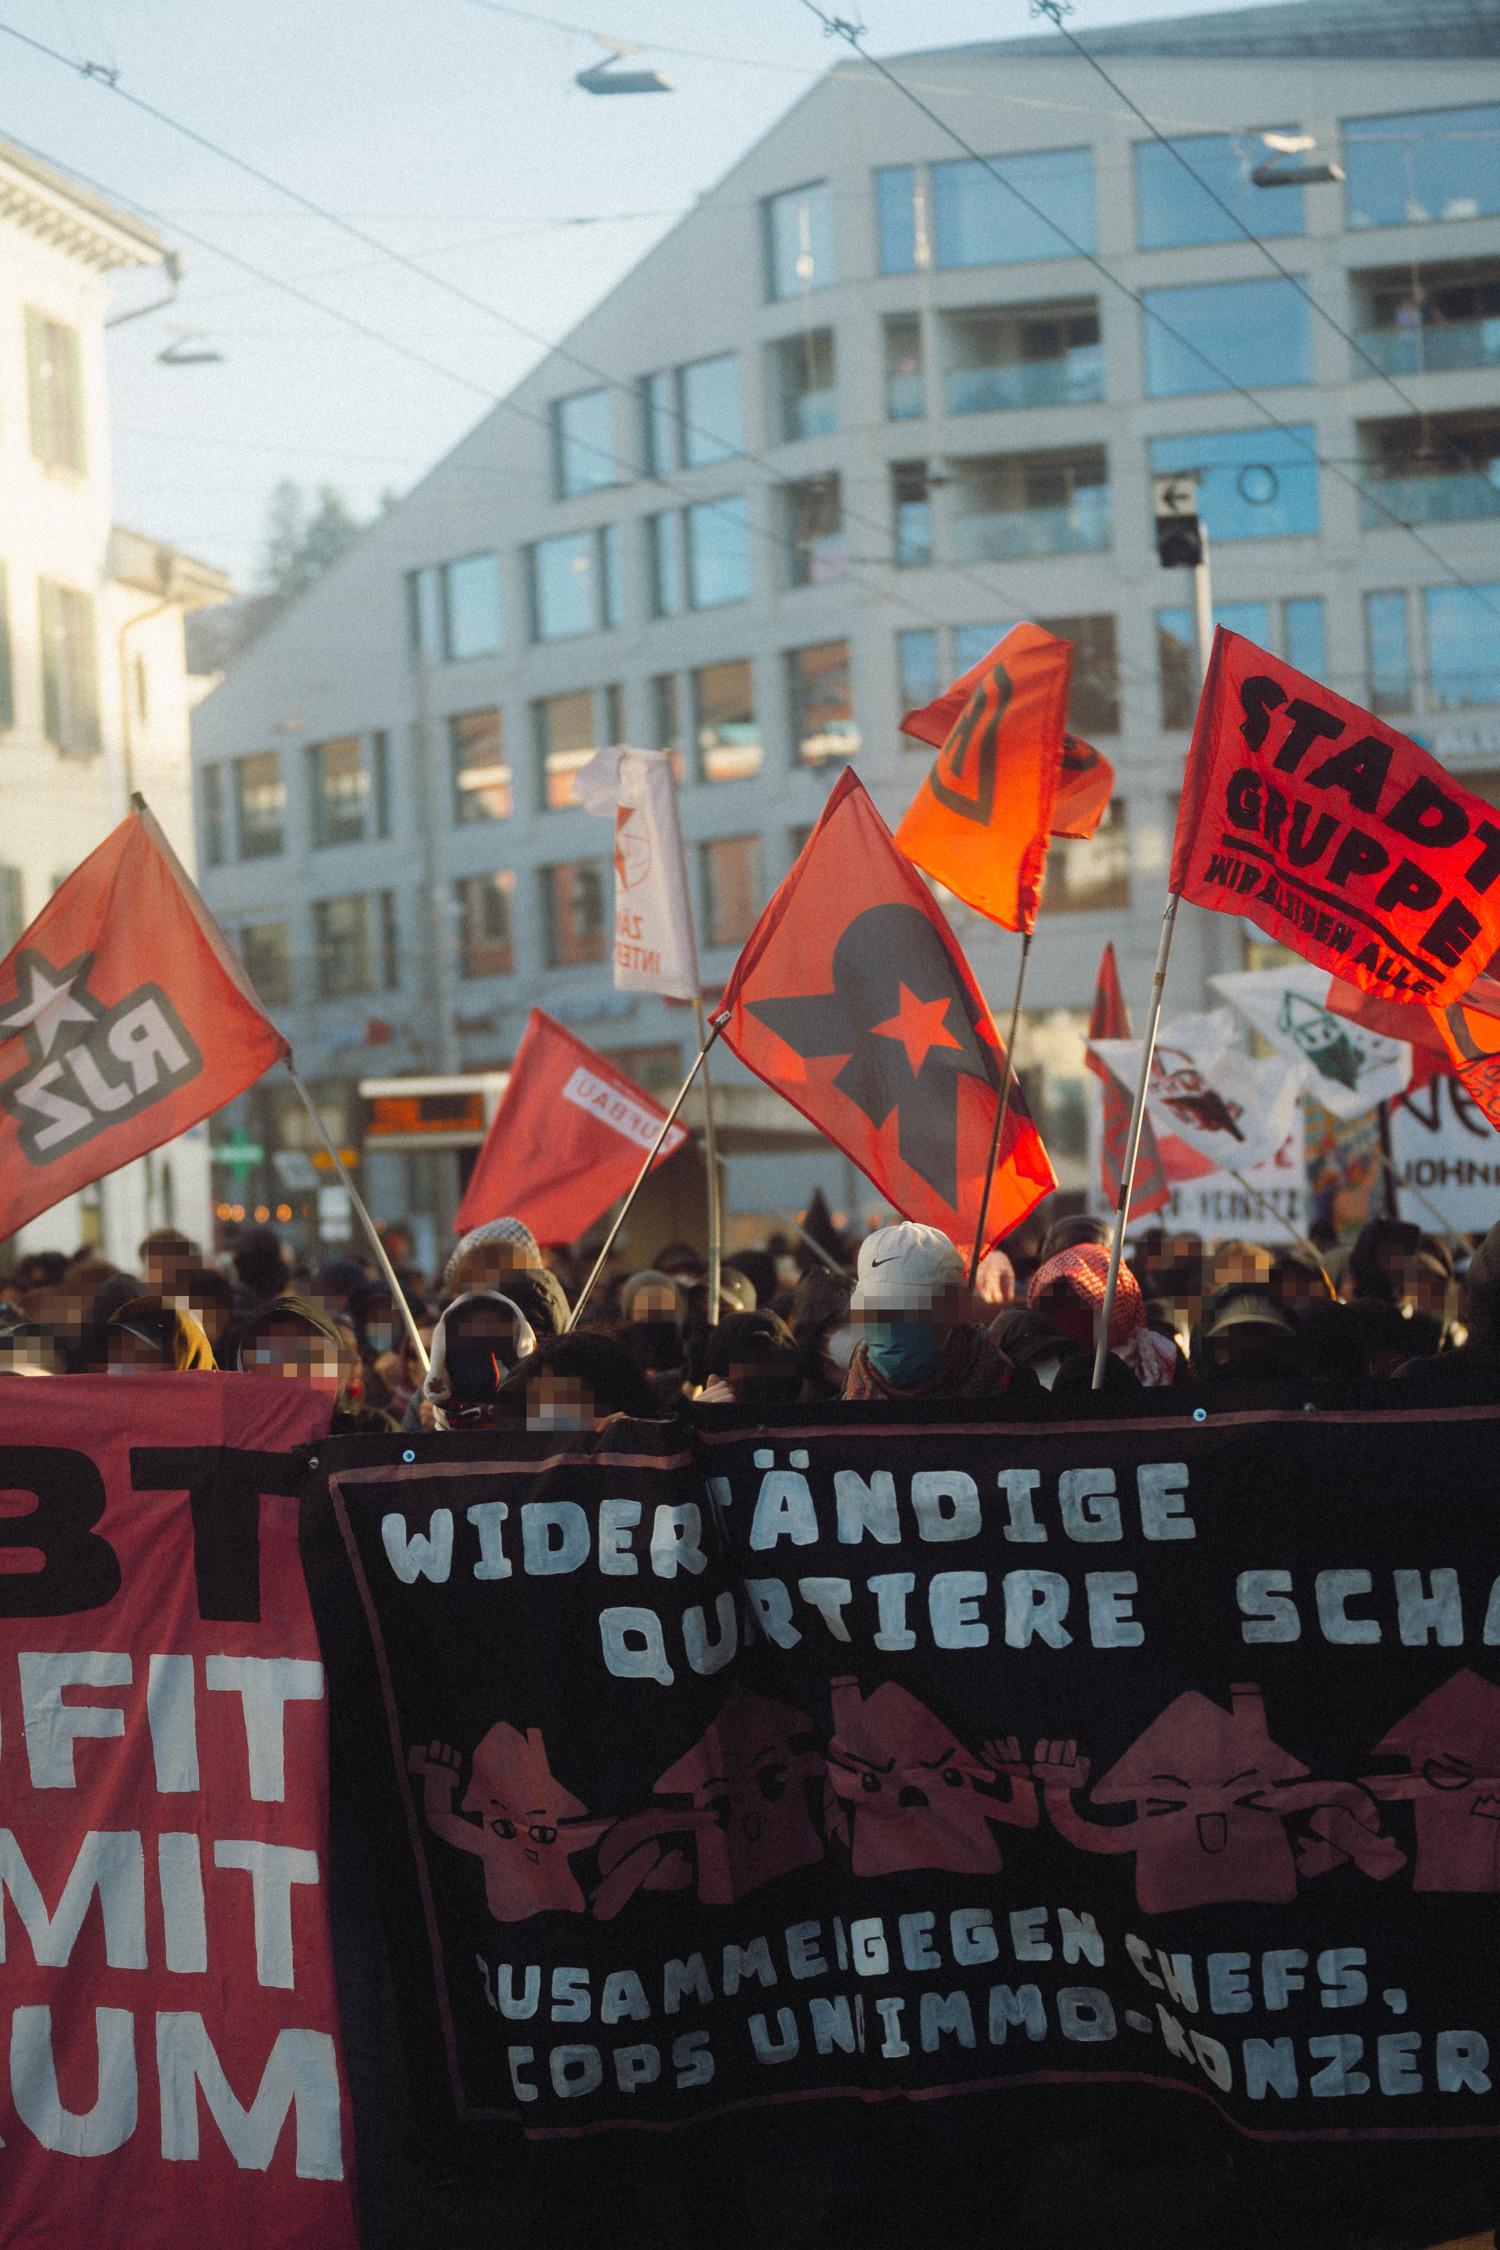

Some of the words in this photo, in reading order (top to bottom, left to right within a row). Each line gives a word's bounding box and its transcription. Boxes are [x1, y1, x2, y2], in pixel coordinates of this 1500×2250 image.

[1239, 675, 1500, 895] STADT
[1203, 854, 1263, 895] WIR
[1255, 875, 1356, 954] BLEIBEN
[1353, 942, 1435, 996] ALLE
[1226, 767, 1482, 968] GRUPPE
[1394, 1158, 1500, 1188] OHN
[381, 1449, 1197, 1585] WIDERÄNDIGE
[599, 1571, 1145, 1687] QURTIERE
[1236, 1568, 1500, 1647] SCH
[0, 1651, 324, 1802] FIT
[476, 1916, 850, 2024] USAMME
[850, 1906, 1105, 1977] GEGEN
[1125, 1932, 1408, 2014] CHEFS,
[0, 2004, 345, 2182] UM
[508, 2030, 715, 2102] COPS
[748, 1994, 865, 2065] UN
